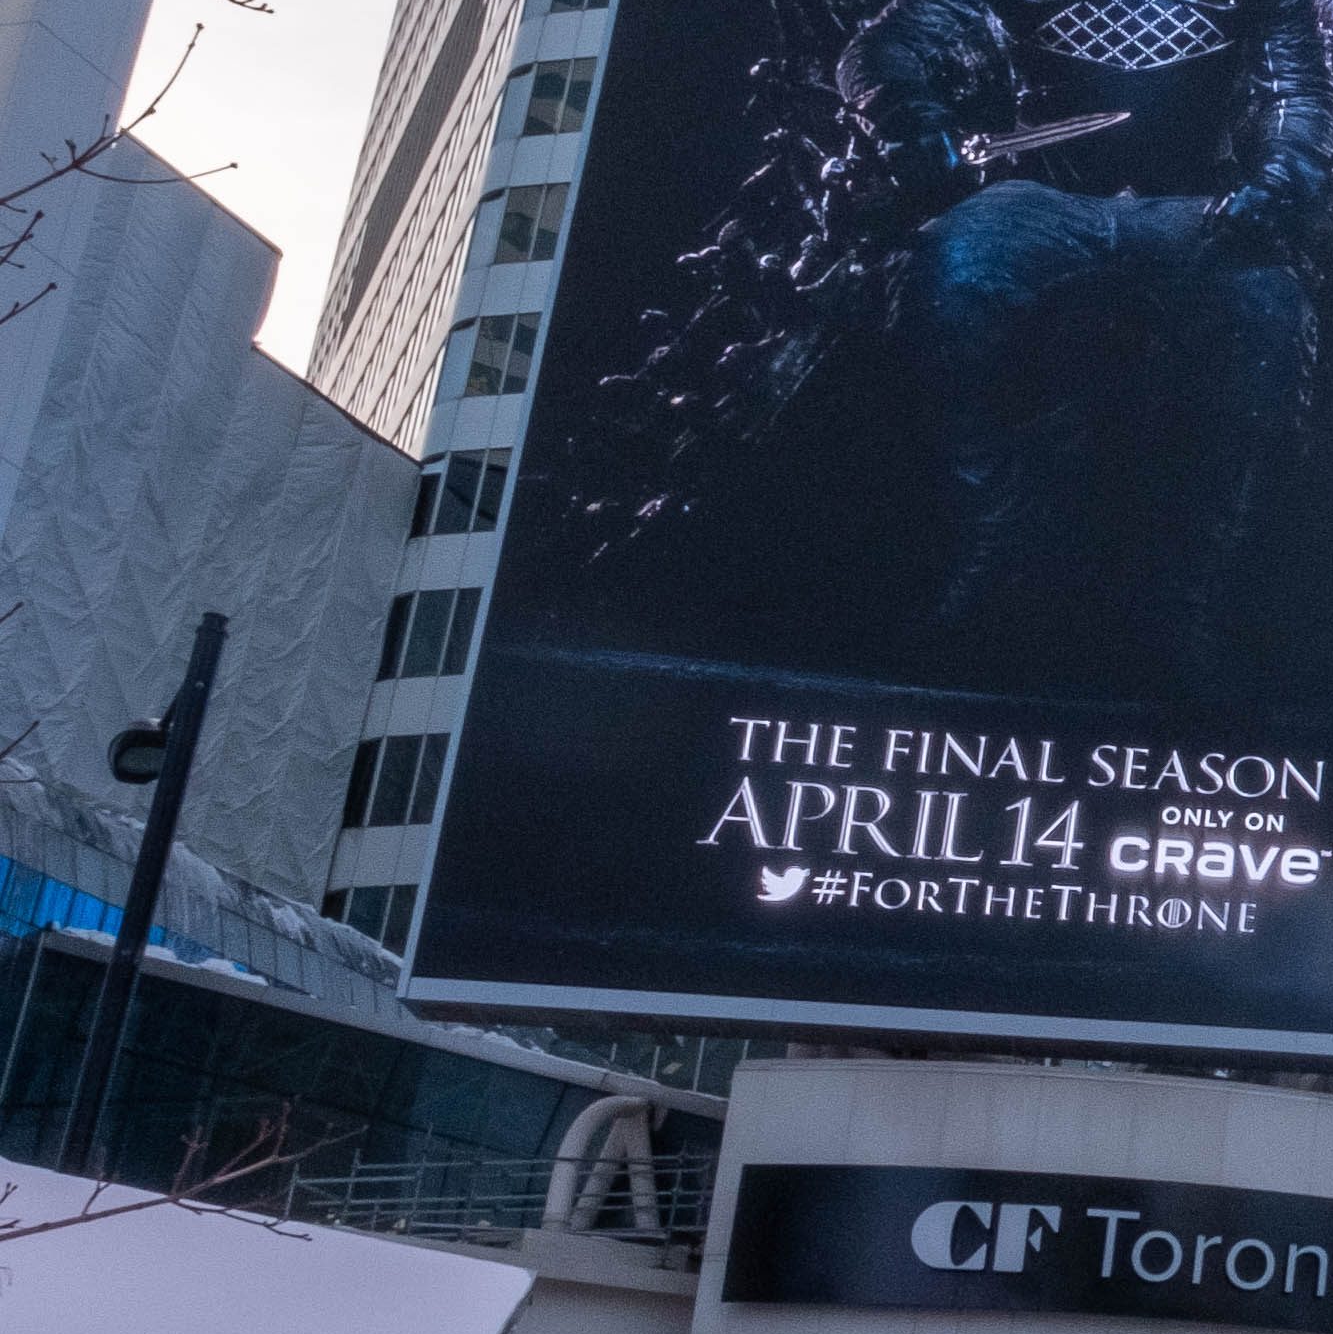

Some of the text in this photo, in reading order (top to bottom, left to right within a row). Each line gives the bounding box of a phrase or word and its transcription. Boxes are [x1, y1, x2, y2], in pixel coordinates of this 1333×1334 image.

[729, 716, 1325, 804] THE FINAL SEASON
[696, 775, 1086, 870] APRIL 14
[1160, 805, 1285, 834] ONLY ON
[911, 1200, 1061, 1273] CF
